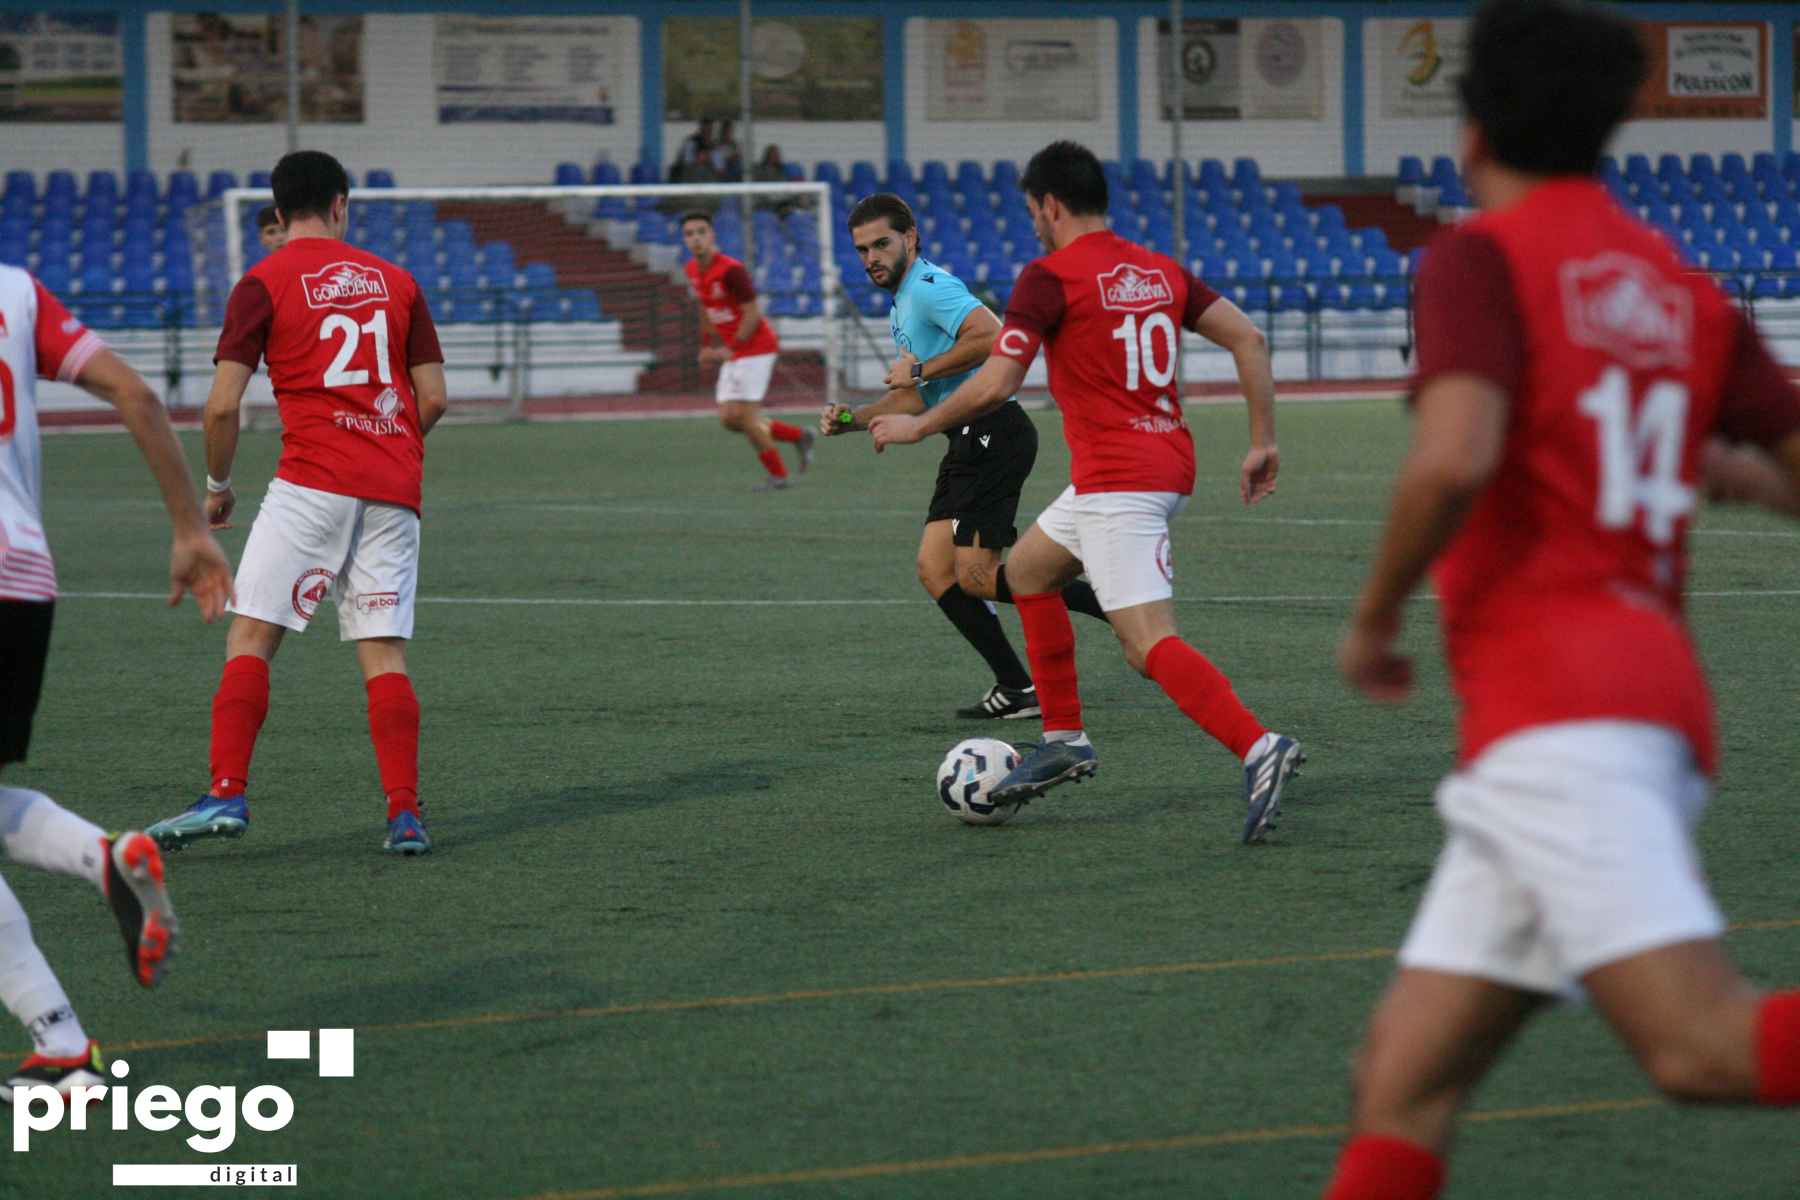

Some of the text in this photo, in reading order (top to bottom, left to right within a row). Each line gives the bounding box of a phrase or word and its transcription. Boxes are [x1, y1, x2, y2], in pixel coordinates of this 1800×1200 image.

[320, 310, 392, 388] 21
[1000, 330, 1029, 355] C
[1113, 312, 1177, 391] 10
[1578, 366, 1695, 544] 14
